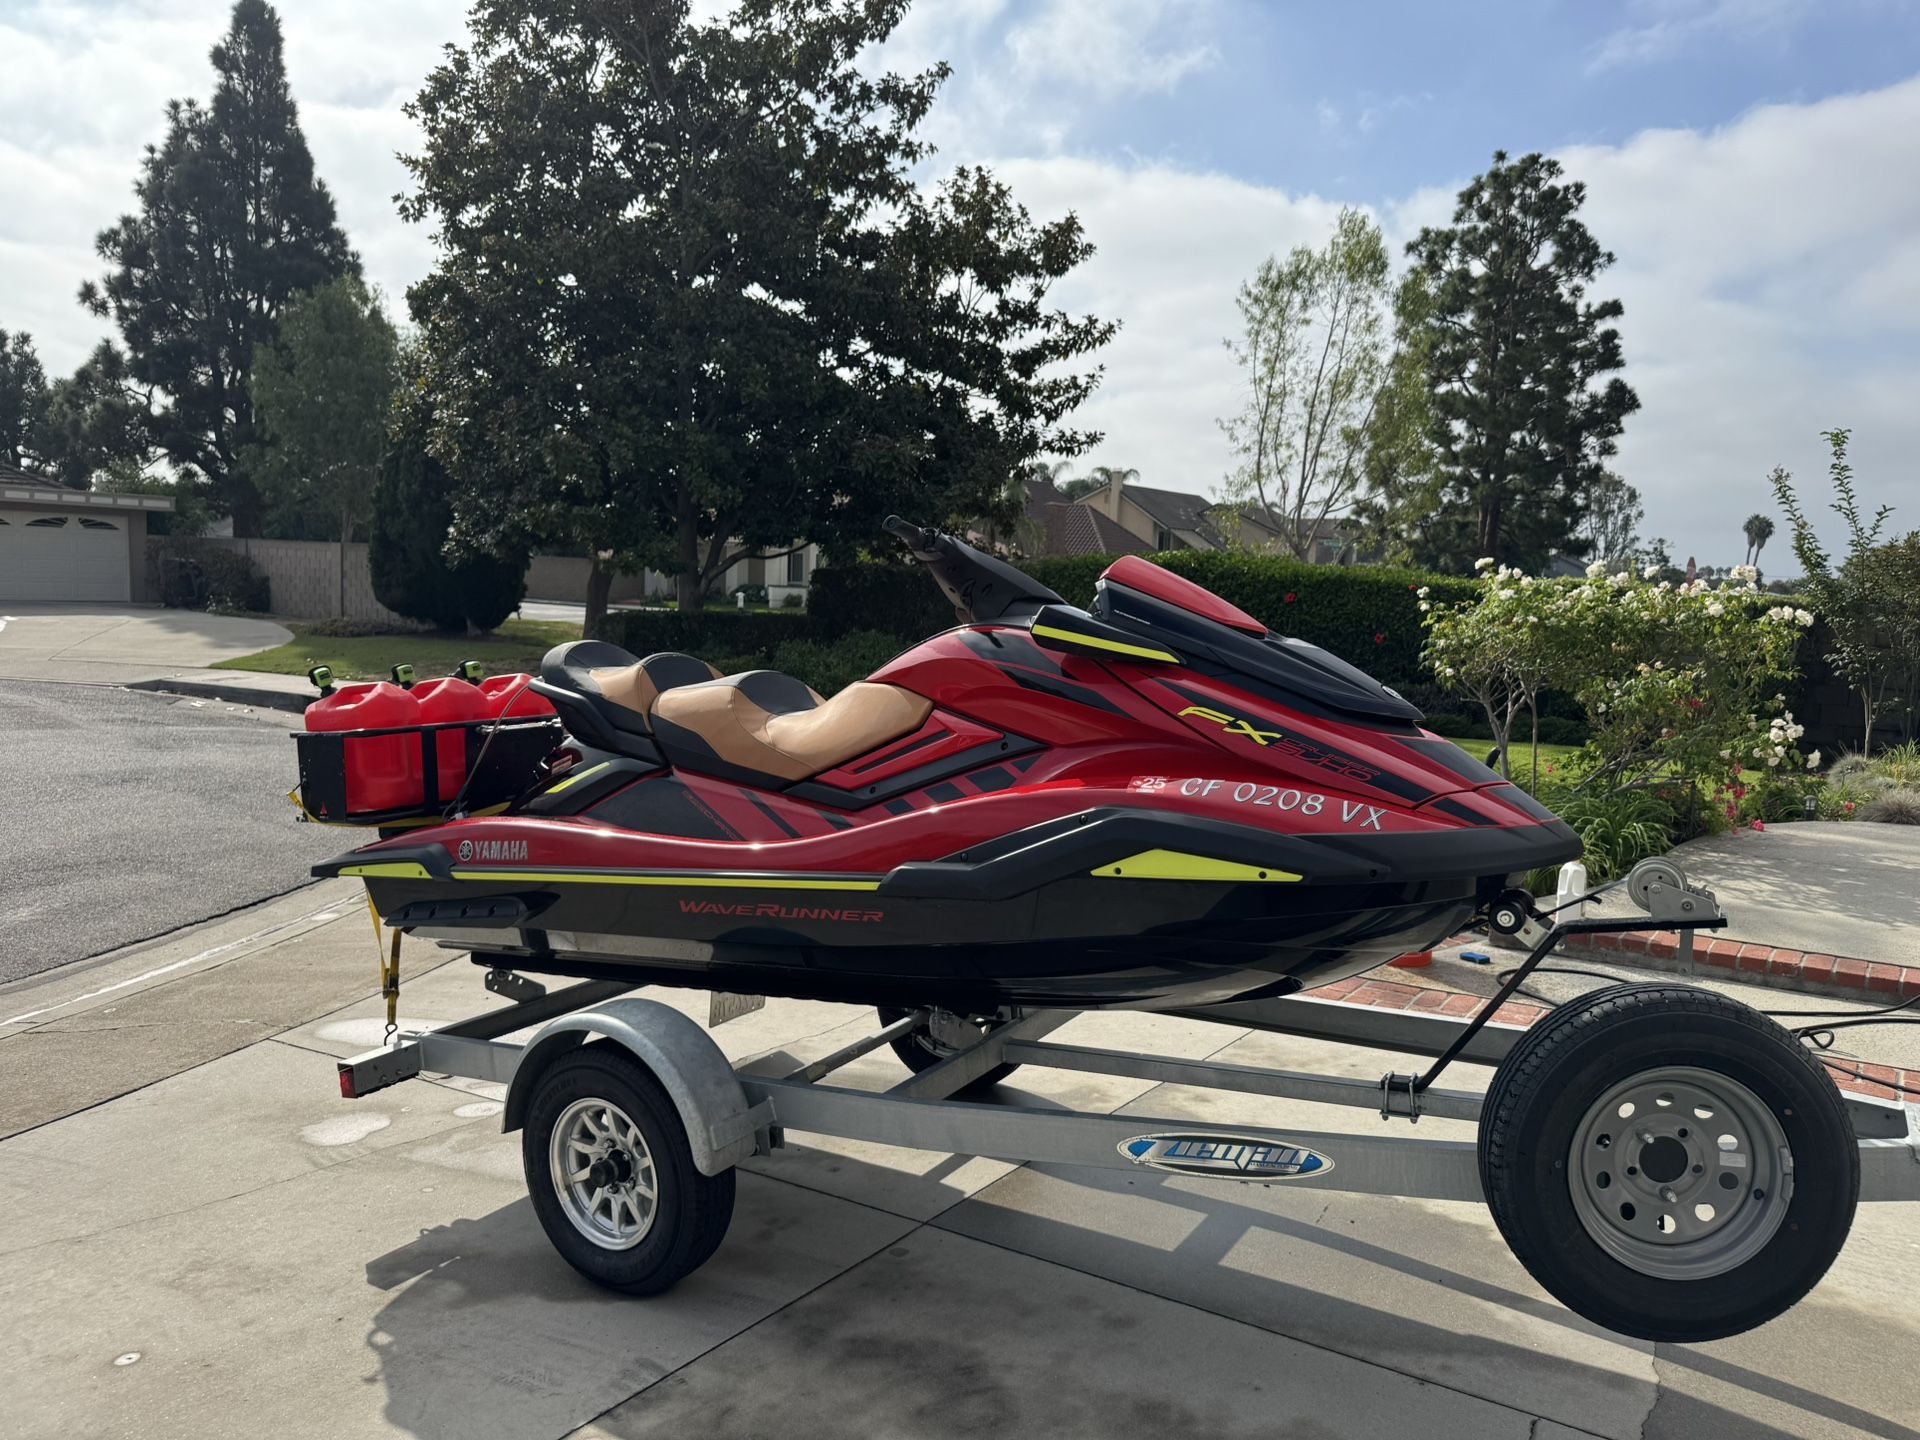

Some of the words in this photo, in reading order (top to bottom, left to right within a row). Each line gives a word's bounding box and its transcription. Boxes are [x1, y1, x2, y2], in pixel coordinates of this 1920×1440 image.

[1177, 706, 1282, 746] FX
[1141, 777, 1167, 789] 25
[1180, 777, 1225, 797] CF
[1233, 782, 1325, 816] 0208
[1342, 800, 1388, 831] VX
[475, 840, 528, 860] YAMAHA
[678, 900, 884, 922] WAVERUNNER
